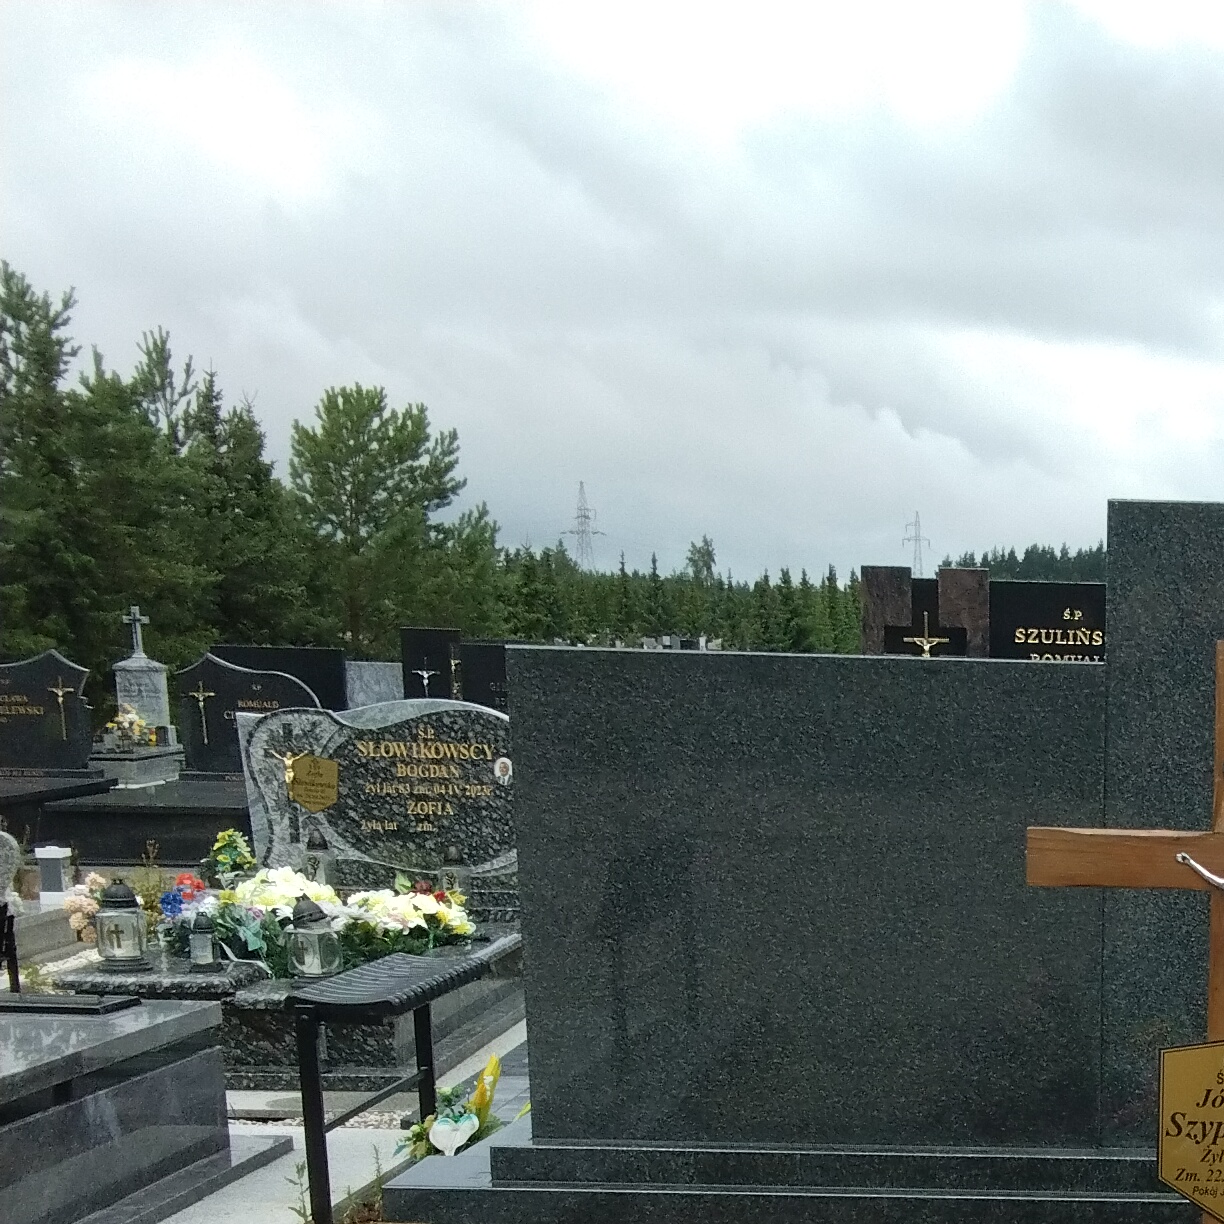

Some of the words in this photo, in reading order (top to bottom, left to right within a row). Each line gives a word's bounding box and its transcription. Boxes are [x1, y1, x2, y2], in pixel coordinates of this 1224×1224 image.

[1014, 627, 1103, 646] SZULIŃS
[395, 763, 462, 778] BOGDAN
[407, 801, 454, 816] ZOFIA
[1174, 1168, 1200, 1182] Zm.
[1192, 1185, 1218, 1198] Pokój
